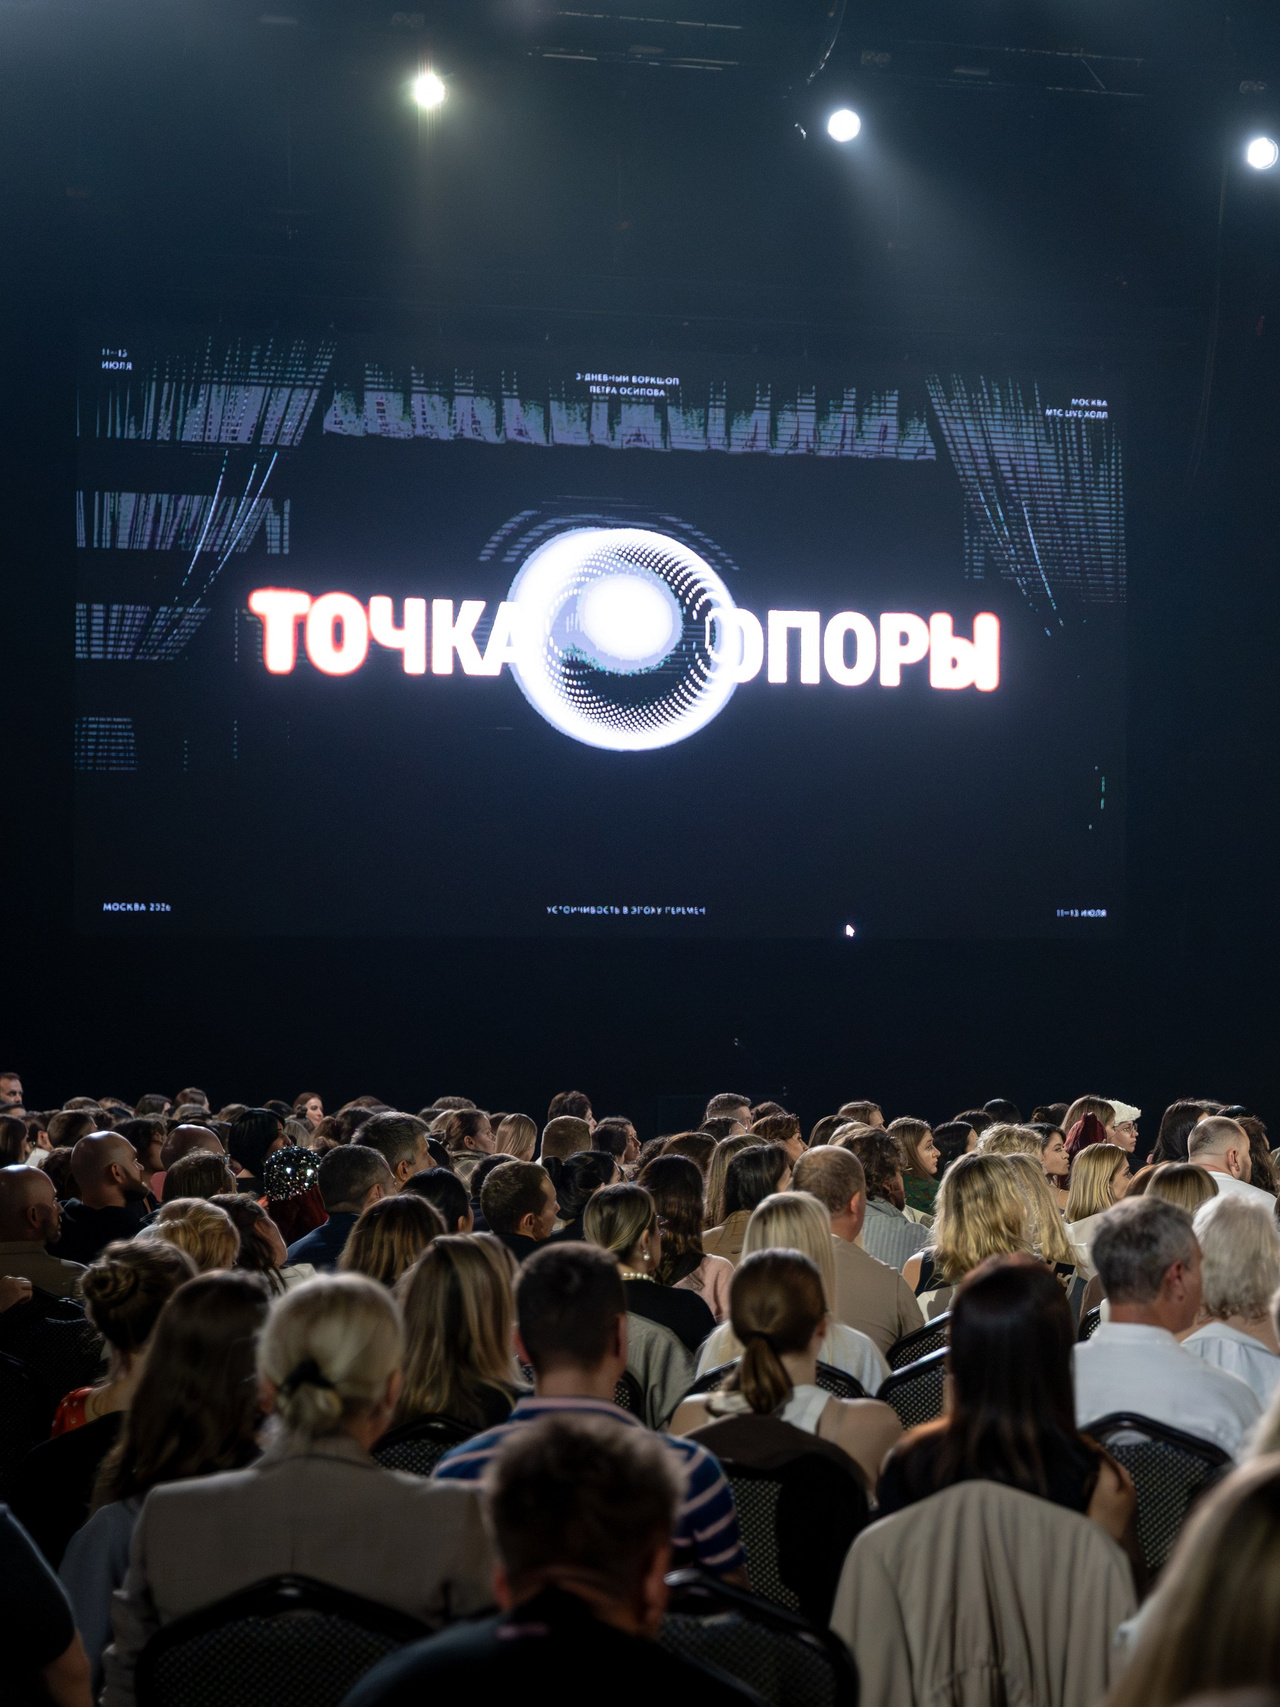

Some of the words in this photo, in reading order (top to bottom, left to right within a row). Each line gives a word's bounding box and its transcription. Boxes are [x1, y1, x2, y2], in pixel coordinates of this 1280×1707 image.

[101, 361, 133, 371] ИЮЛЯ
[631, 374, 680, 386] ВОРКШОП
[589, 385, 618, 394] ПЕТРА
[619, 386, 666, 397] ОСИПОВА
[1071, 398, 1108, 407] МОСКВА
[1045, 408, 1064, 417] МТС
[1064, 409, 1083, 418] LIVE
[1084, 410, 1109, 419] ХОЛЛ
[249, 587, 522, 676] ТОЧКА
[704, 607, 1001, 692] ОПОРЫ
[102, 902, 147, 912] МОСКВА
[622, 905, 629, 915] В
[1080, 909, 1107, 918] ИЮЛЯ
